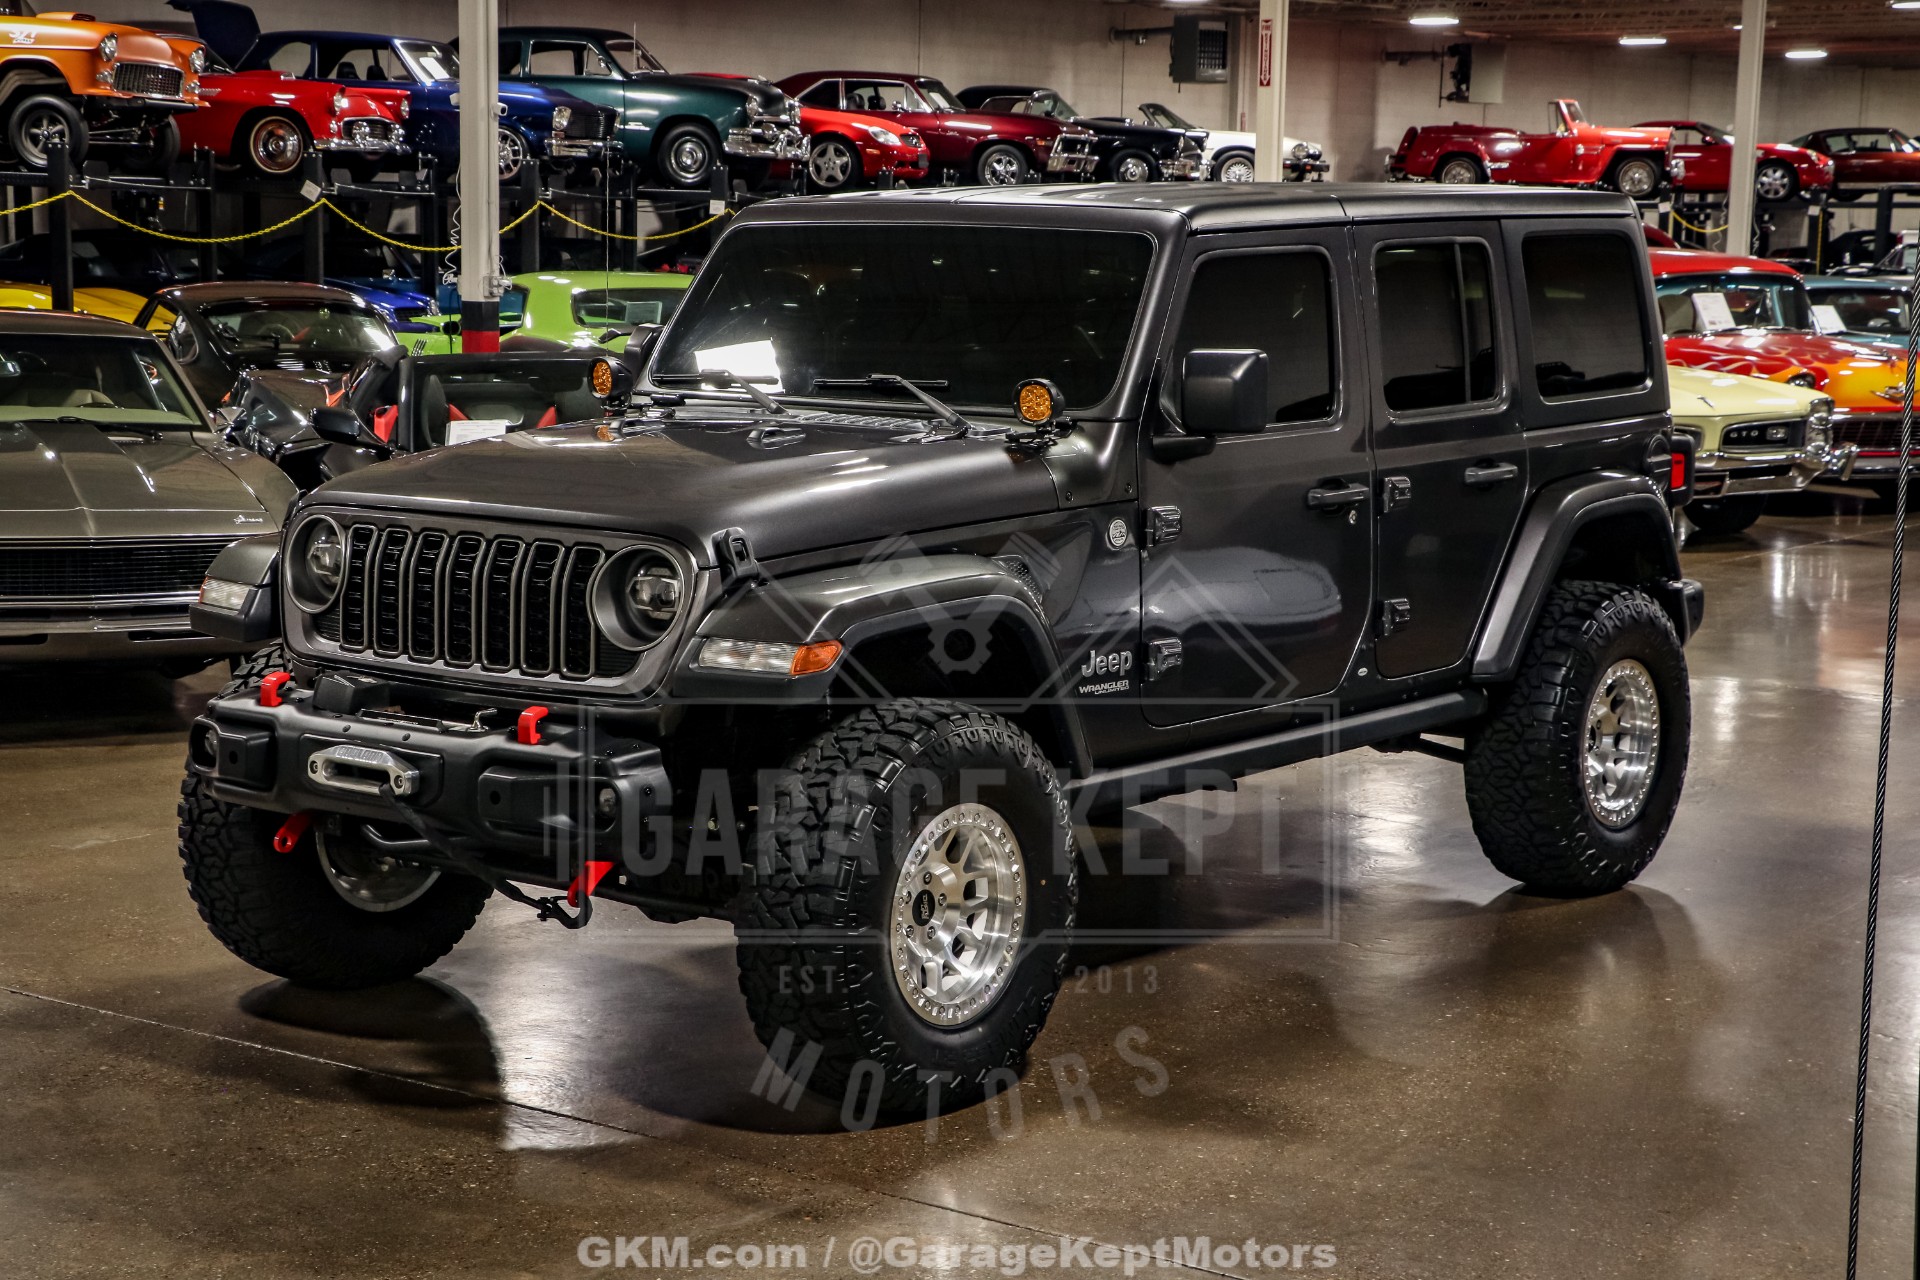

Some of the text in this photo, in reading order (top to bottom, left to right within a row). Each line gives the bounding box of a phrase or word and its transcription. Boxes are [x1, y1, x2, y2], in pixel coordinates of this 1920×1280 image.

[1730, 430, 1759, 438] GTO
[1081, 650, 1132, 677] Jeep
[1079, 680, 1129, 694] WRANGLER
